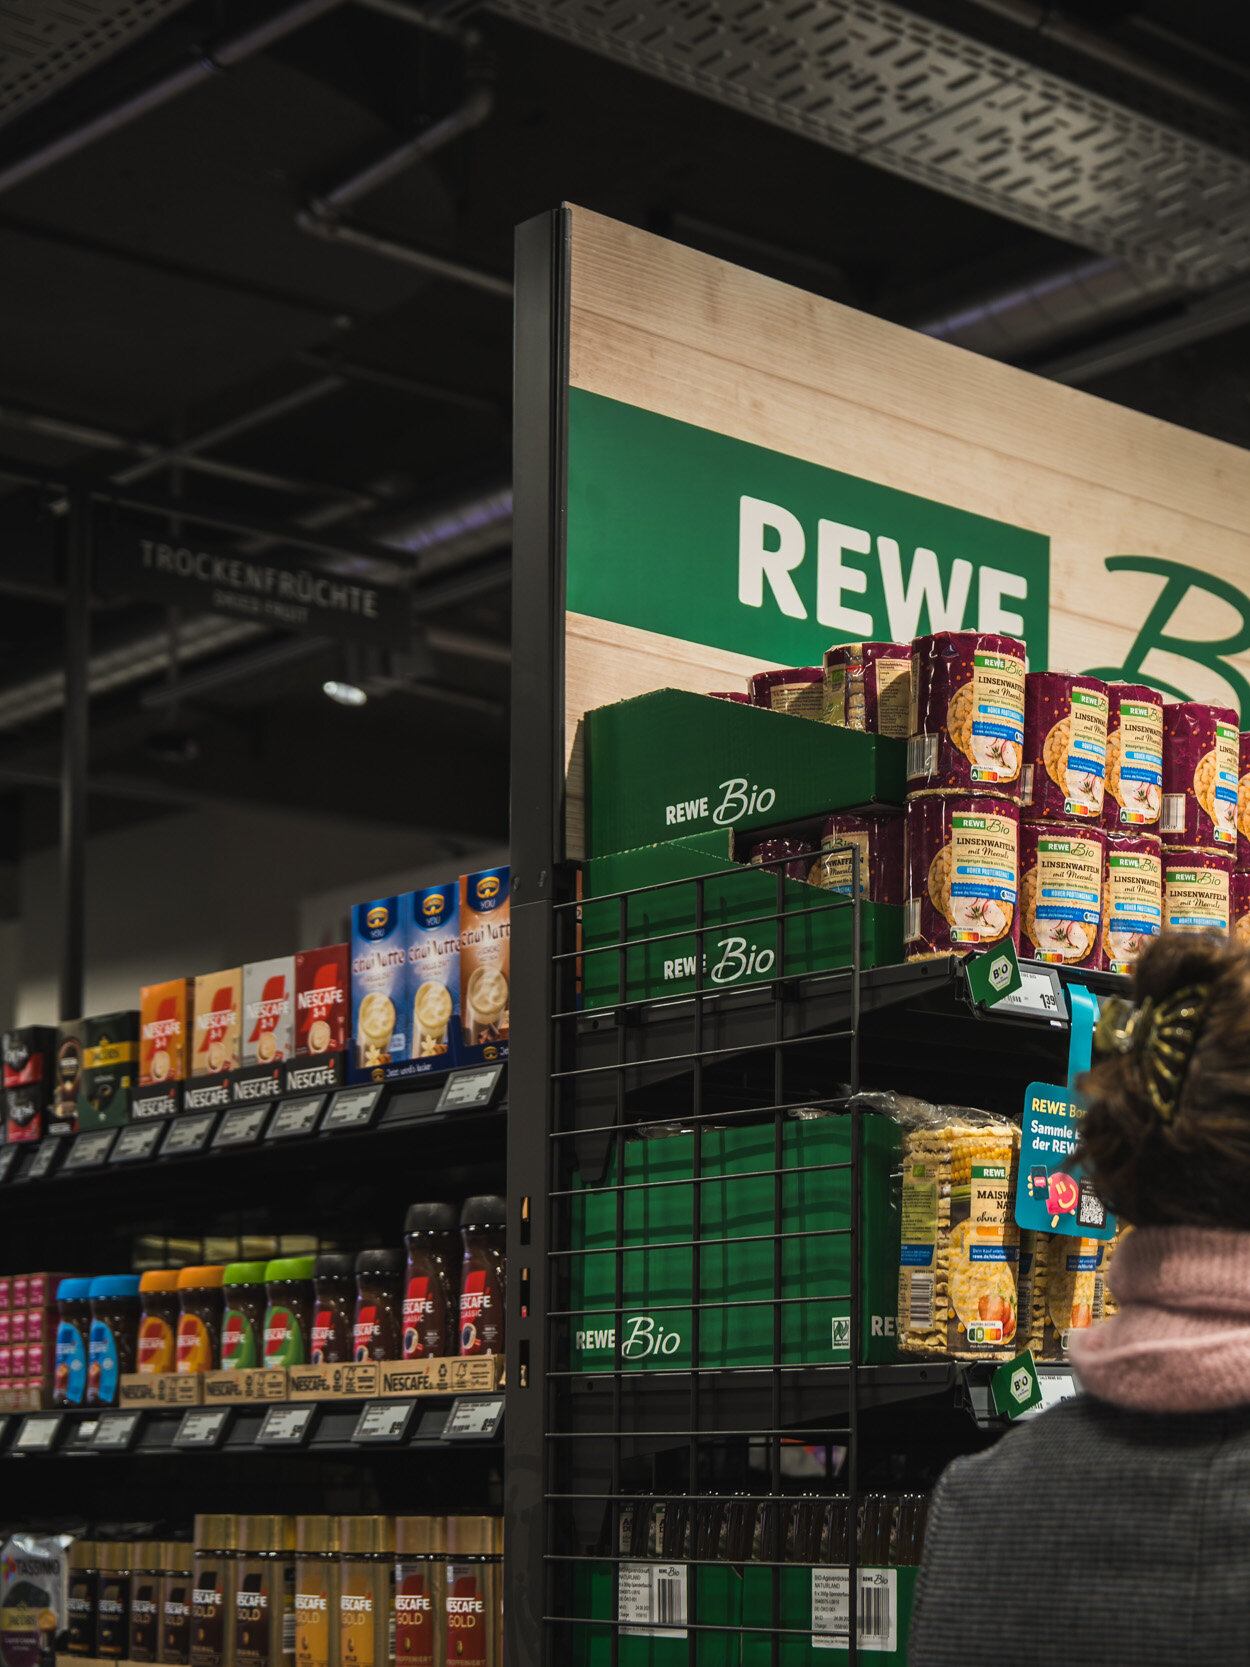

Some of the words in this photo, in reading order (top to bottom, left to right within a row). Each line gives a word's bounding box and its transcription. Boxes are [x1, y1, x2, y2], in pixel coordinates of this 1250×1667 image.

[139, 539, 379, 618] TROCKENFRÜCHTE
[739, 494, 1029, 673] REWE
[985, 659, 1005, 668] REWE
[1006, 660, 1022, 676] Bio
[1081, 696, 1098, 705] REWE
[1130, 707, 1147, 716] REWE
[666, 797, 708, 825] REWE
[713, 778, 775, 824] Bio
[963, 819, 984, 827] REWE
[987, 819, 1009, 835] Bio
[957, 838, 1015, 853] LINSENWAFFELN
[1048, 843, 1069, 851] REWE
[1071, 843, 1094, 857] Bio
[1042, 861, 1099, 874] LINSENWAFFELN
[1120, 859, 1139, 867] REWE
[1140, 858, 1158, 873] Bio
[1197, 872, 1221, 886] Bio
[1170, 891, 1227, 901] LINSENWAFFELN
[711, 937, 774, 983] Bio
[1032, 1098, 1066, 1116] REWE
[1031, 1120, 1072, 1139] Sammle
[1032, 1137, 1049, 1151] der
[1052, 1140, 1078, 1155] REW
[984, 1169, 1005, 1177] REWE
[977, 1211, 997, 1222] ohne
[871, 1316, 899, 1337] RE
[576, 1329, 616, 1349] REWE
[622, 1317, 680, 1359] Bio
[668, 1567, 679, 1576] Bio
[874, 1575, 888, 1584] Bio
[397, 1613, 424, 1625] GOLD
[448, 1615, 476, 1628] GOLD
